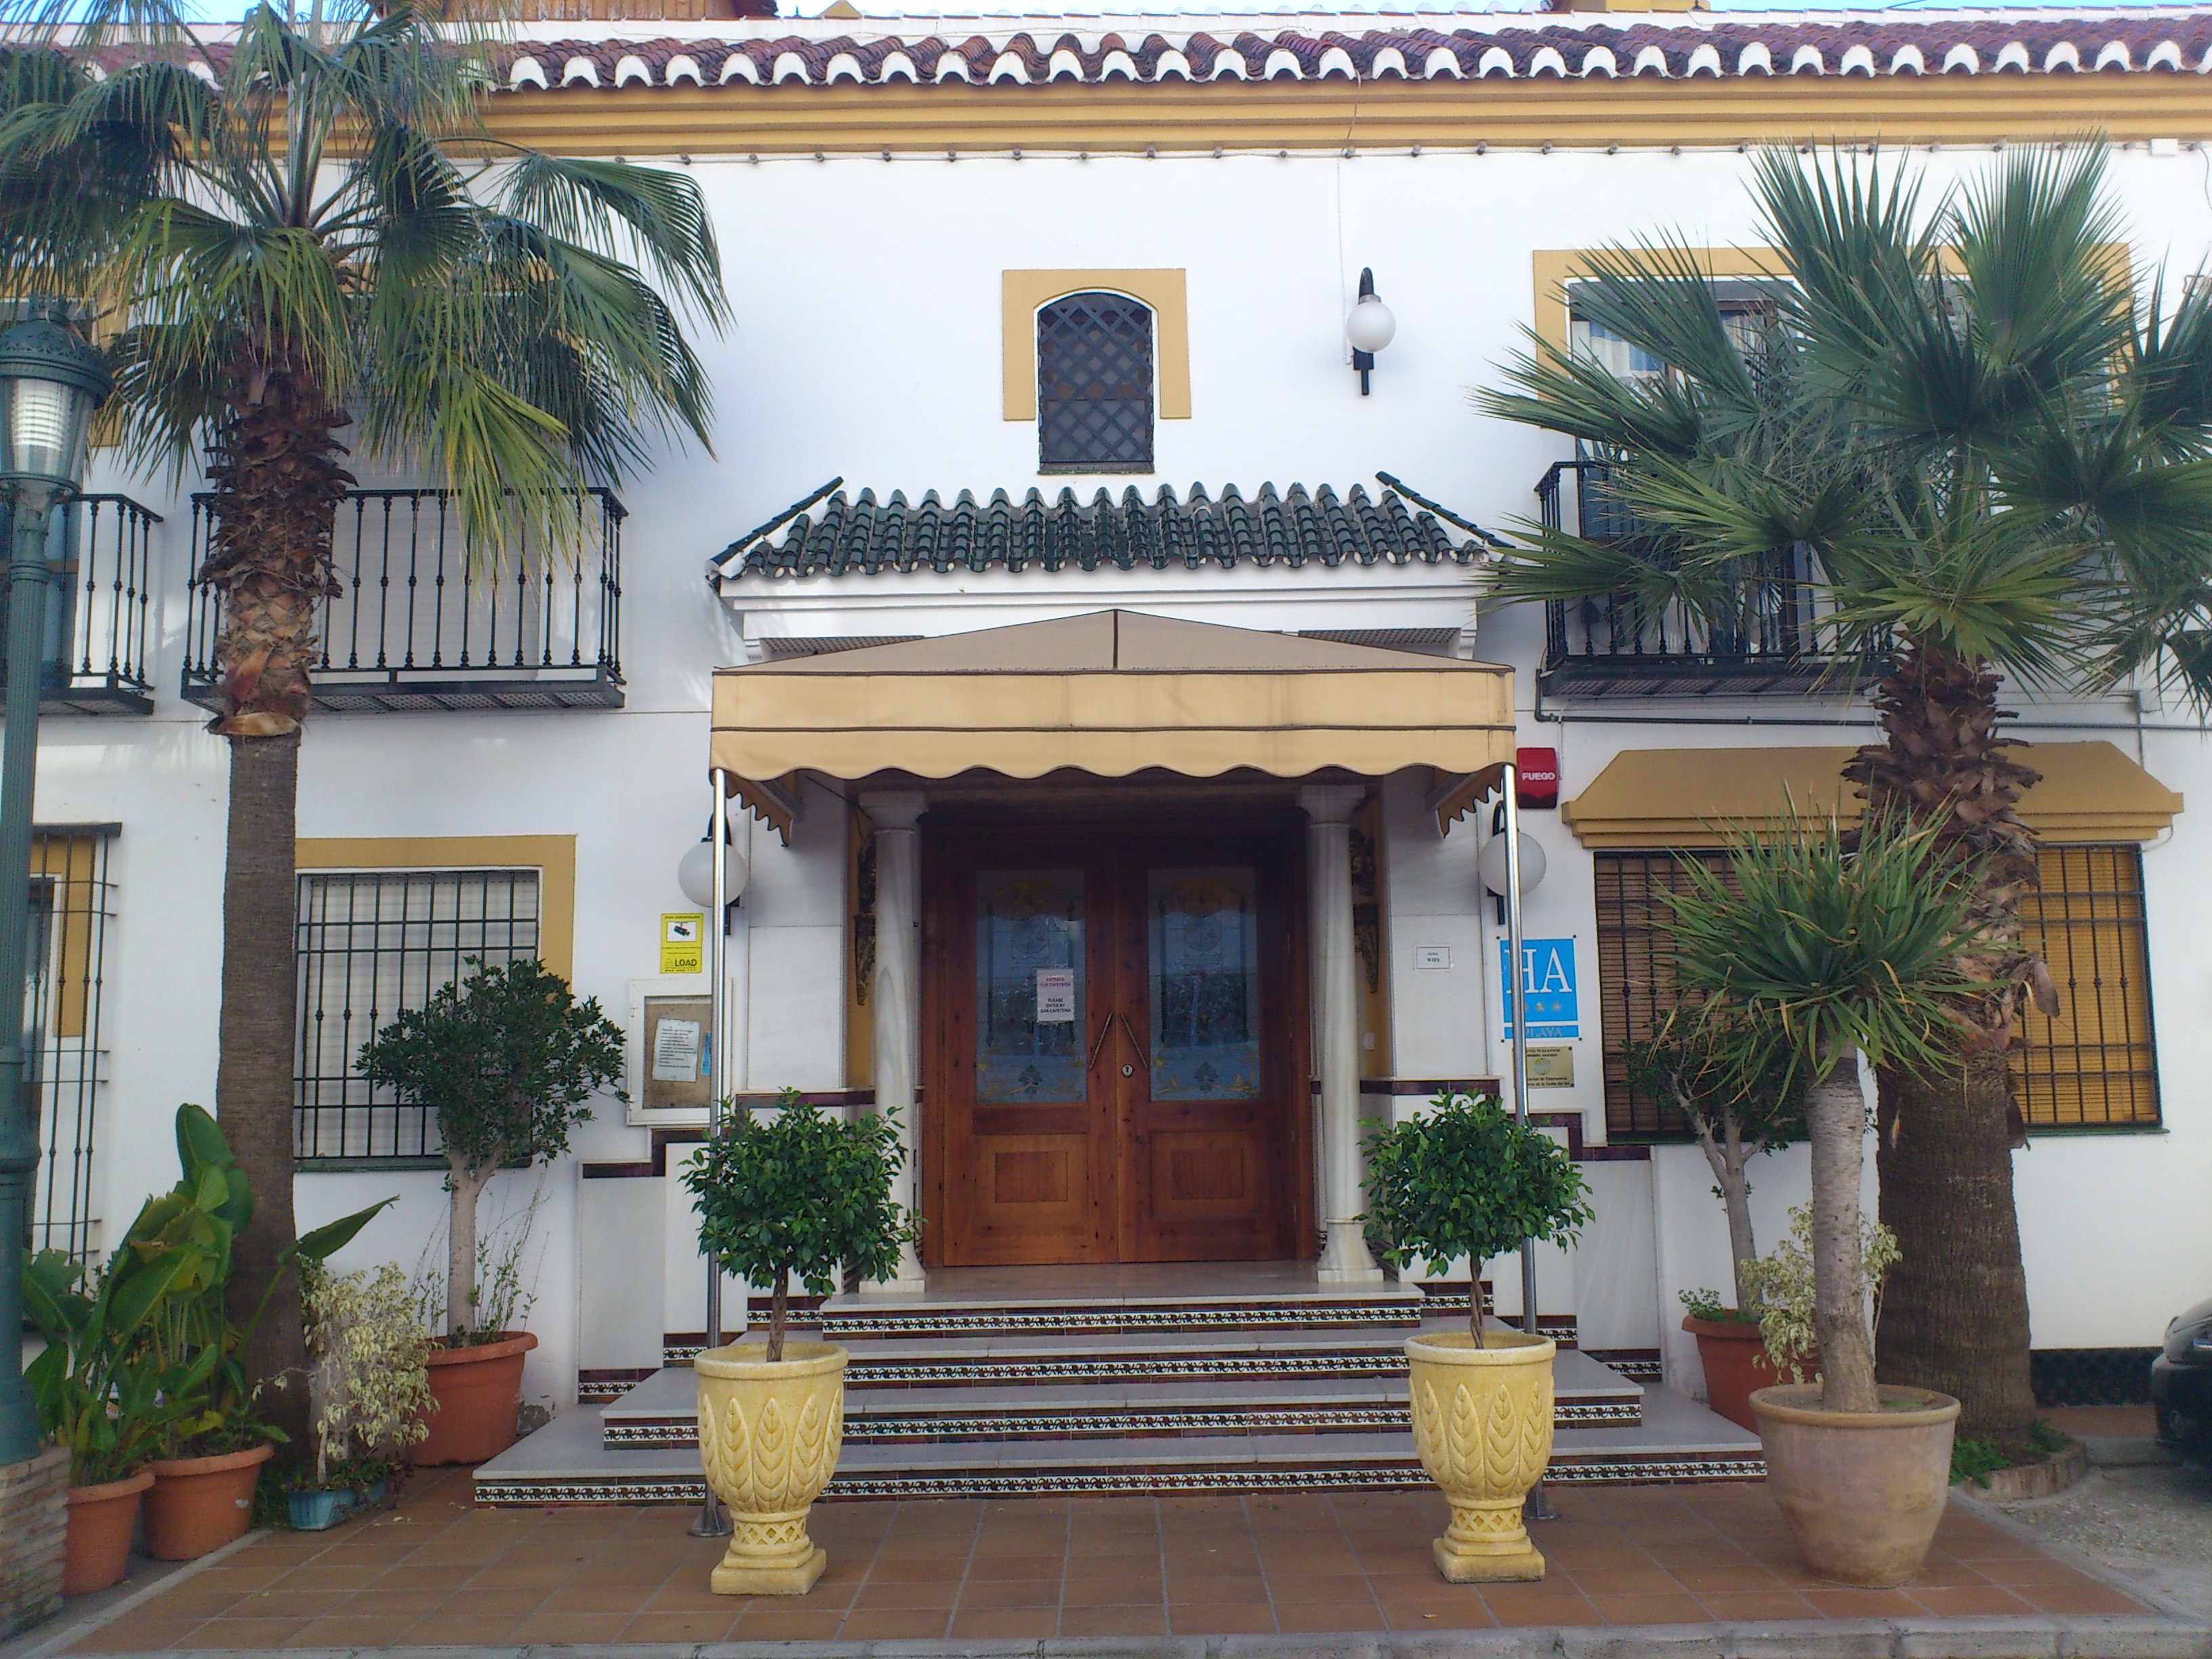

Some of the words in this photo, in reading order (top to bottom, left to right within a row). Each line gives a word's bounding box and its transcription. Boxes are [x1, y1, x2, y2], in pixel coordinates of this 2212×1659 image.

[1521, 771, 1555, 781] FUEGO
[674, 958, 697, 966] LOAD
[1504, 947, 1572, 994] HA
[1525, 1027, 1563, 1038] PLAYA
